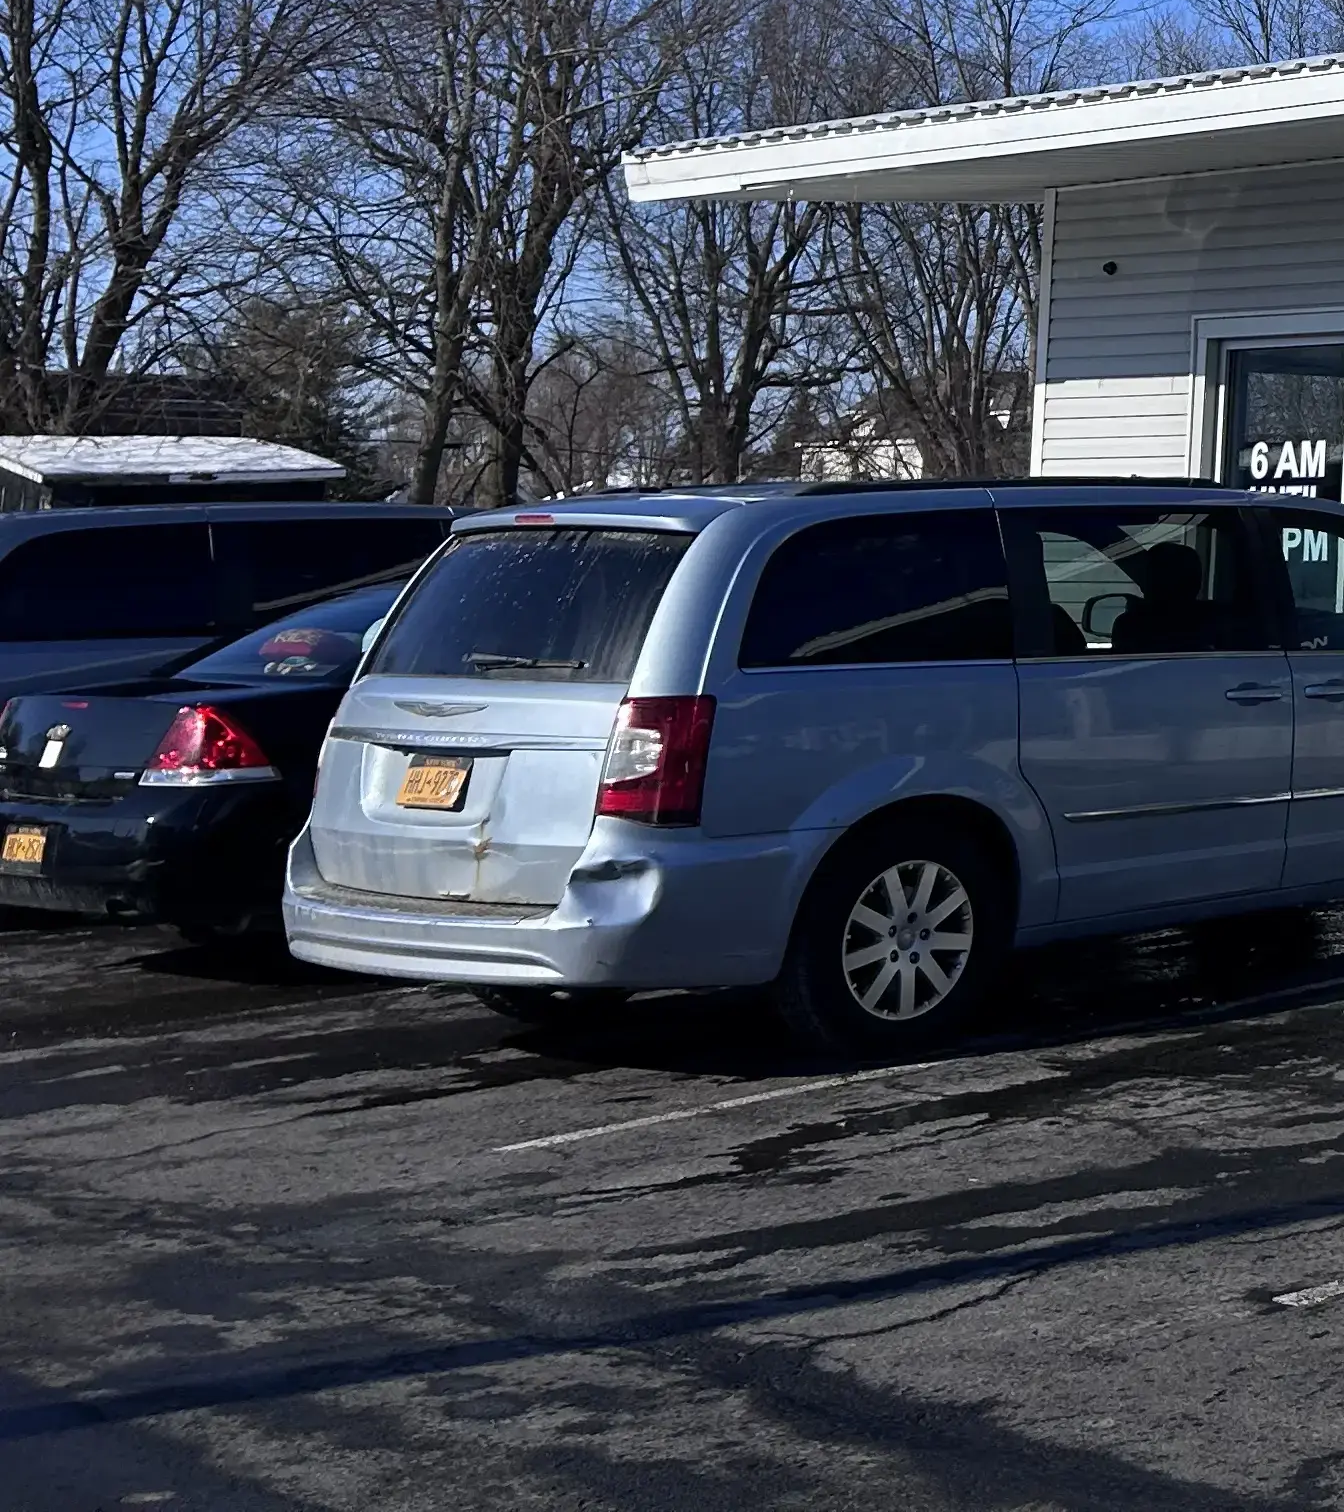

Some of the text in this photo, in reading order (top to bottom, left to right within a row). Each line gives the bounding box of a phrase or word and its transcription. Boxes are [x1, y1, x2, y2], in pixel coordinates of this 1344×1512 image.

[1250, 440, 1327, 479] 6 AM
[1282, 528, 1328, 562] PM
